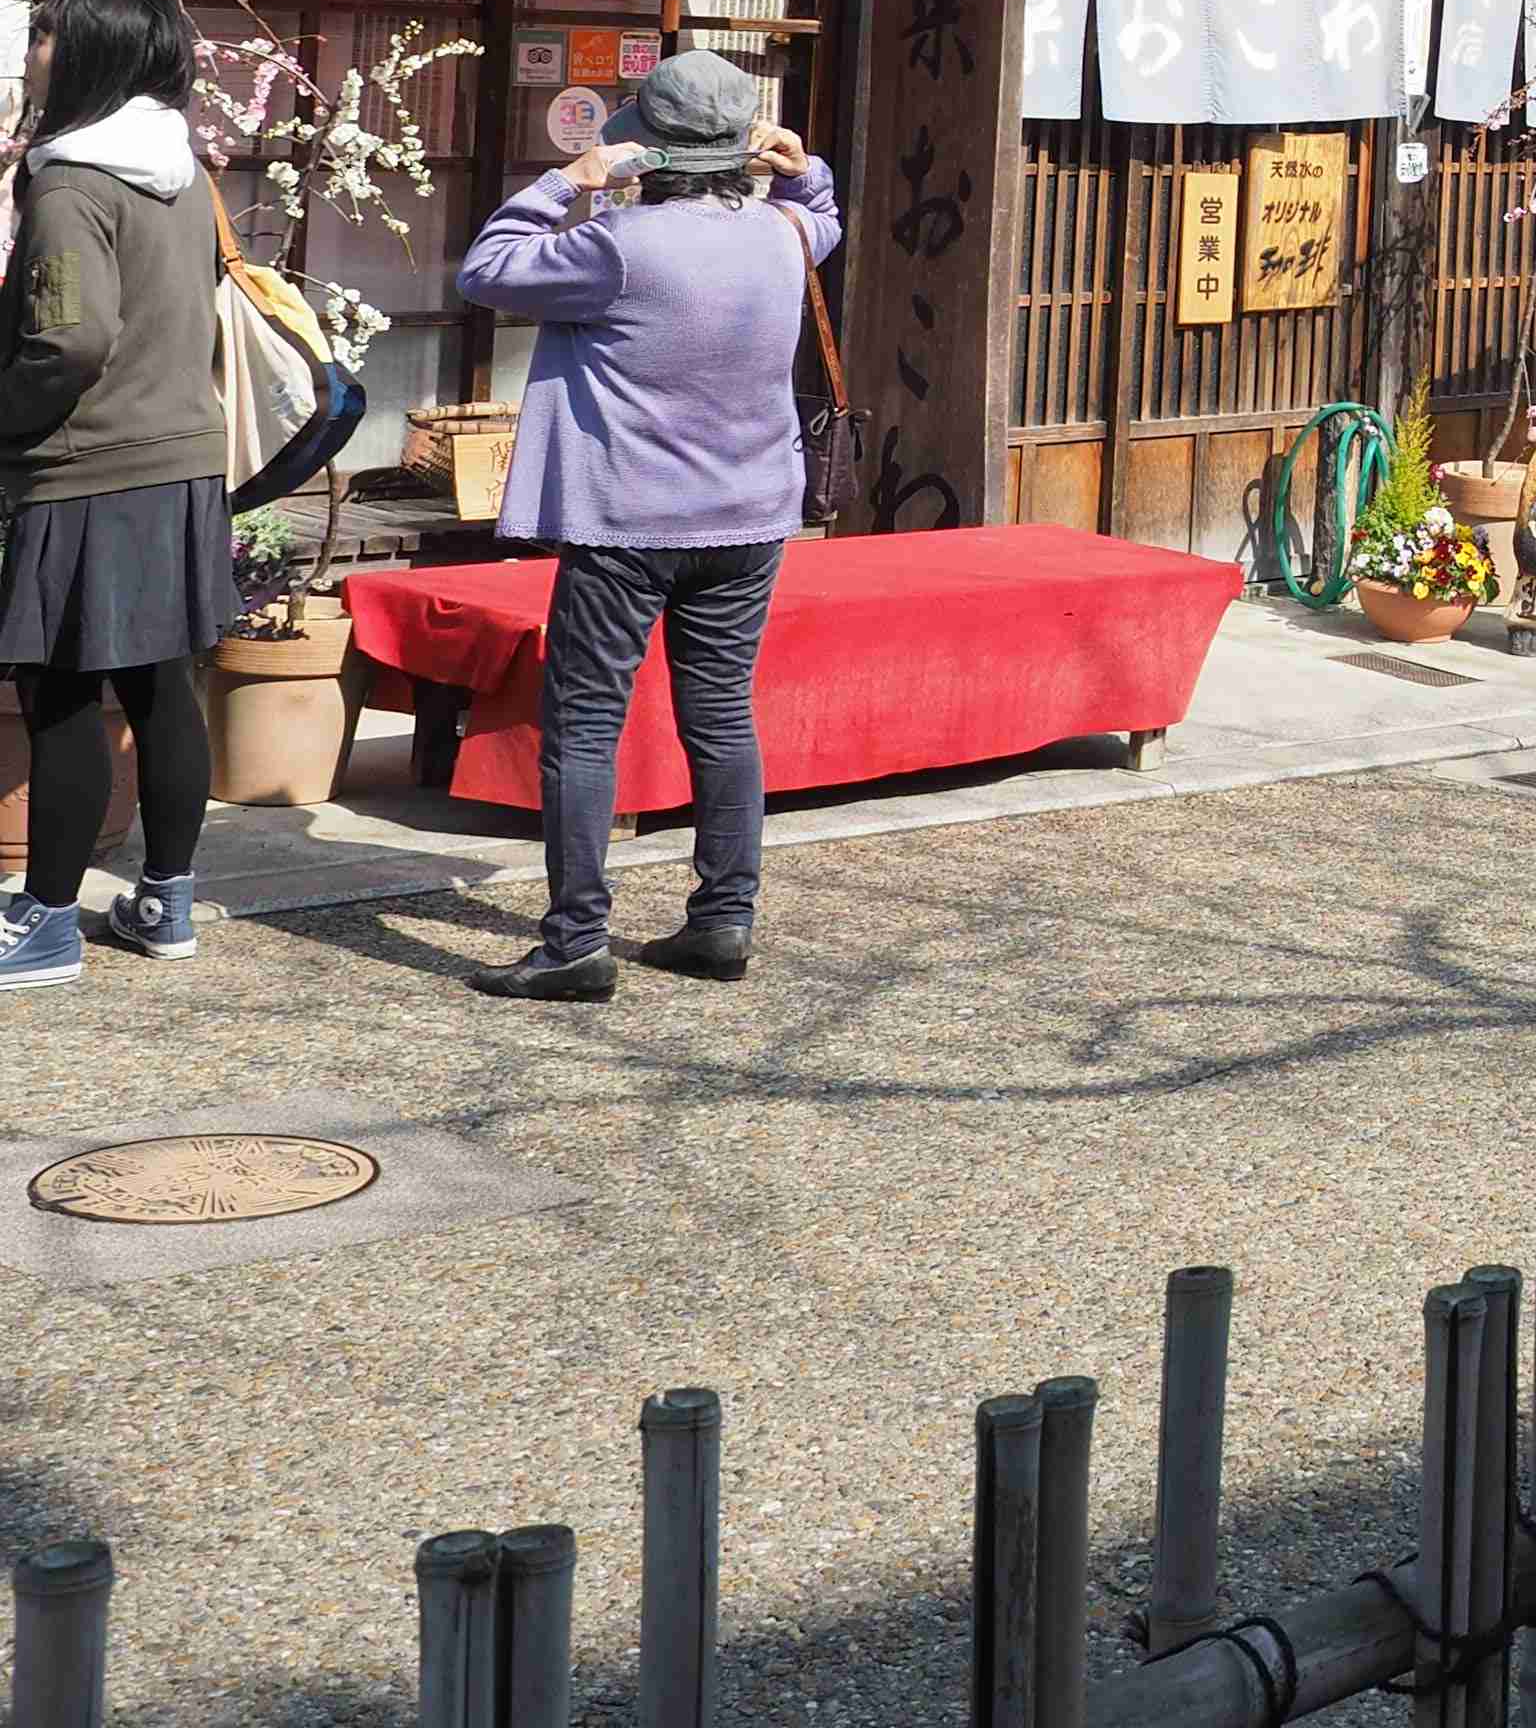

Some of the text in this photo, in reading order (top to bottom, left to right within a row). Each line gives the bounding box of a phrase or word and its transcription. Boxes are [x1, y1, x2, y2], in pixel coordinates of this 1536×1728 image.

[1270, 160, 1324, 178] 天然水の
[1261, 200, 1322, 223] オリジナル
[1197, 196, 1223, 301] 営業中
